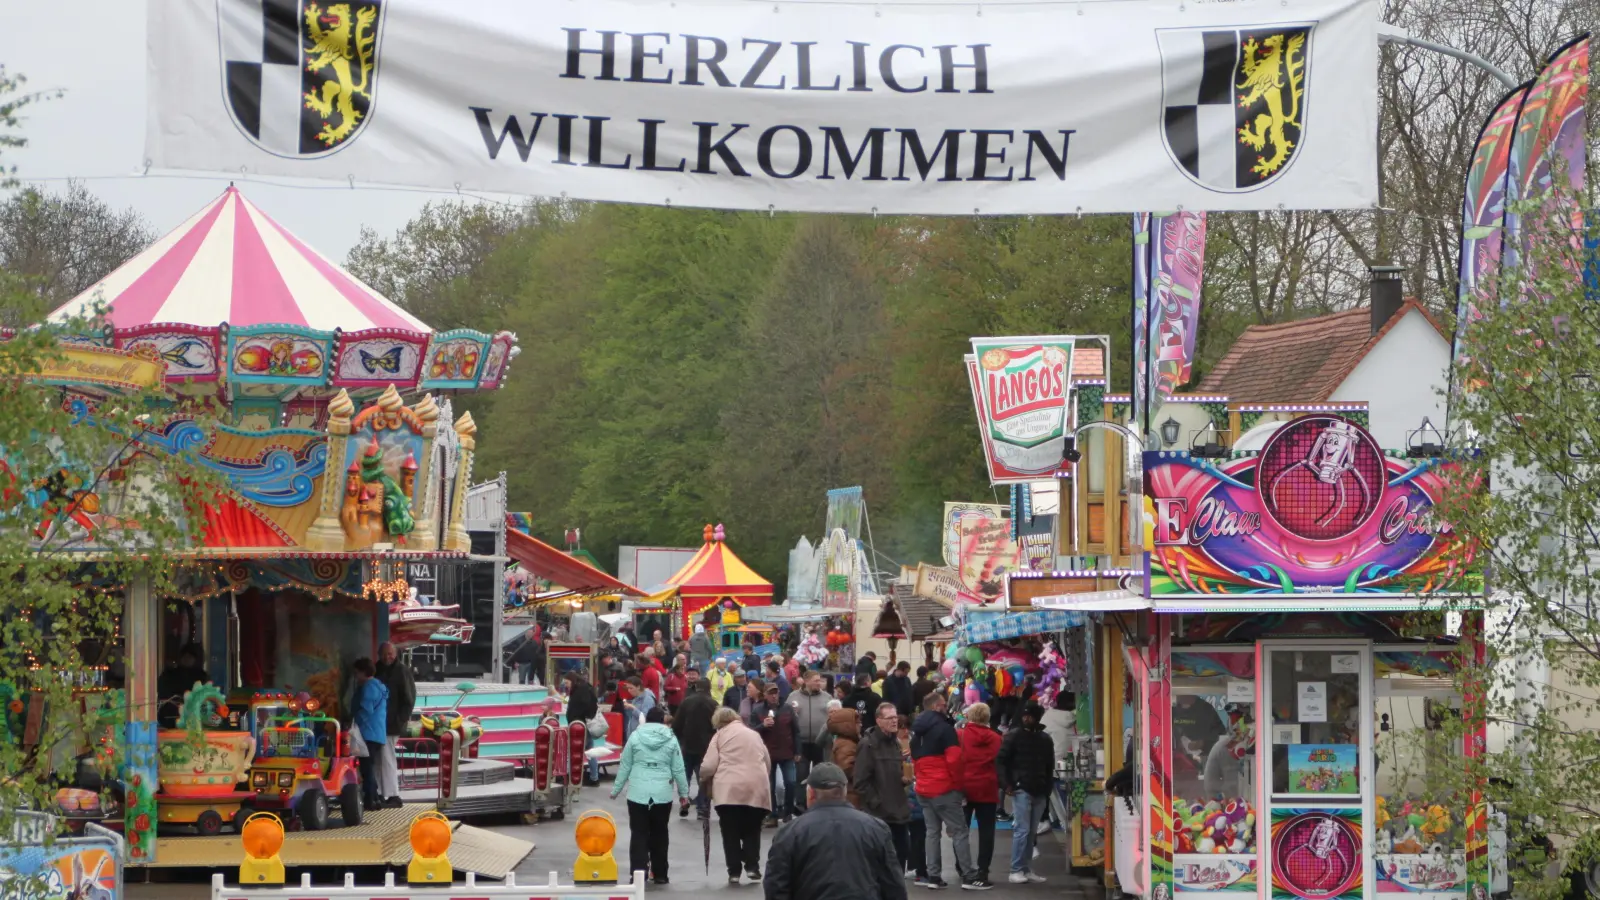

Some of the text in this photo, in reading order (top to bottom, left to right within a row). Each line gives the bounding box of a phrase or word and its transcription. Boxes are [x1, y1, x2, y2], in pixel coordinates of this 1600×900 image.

[559, 27, 995, 94] HERZLICH
[468, 106, 1077, 182] WILLKOMMEN
[988, 363, 1066, 421] LANGOS
[1308, 754, 1337, 762] MARIO
